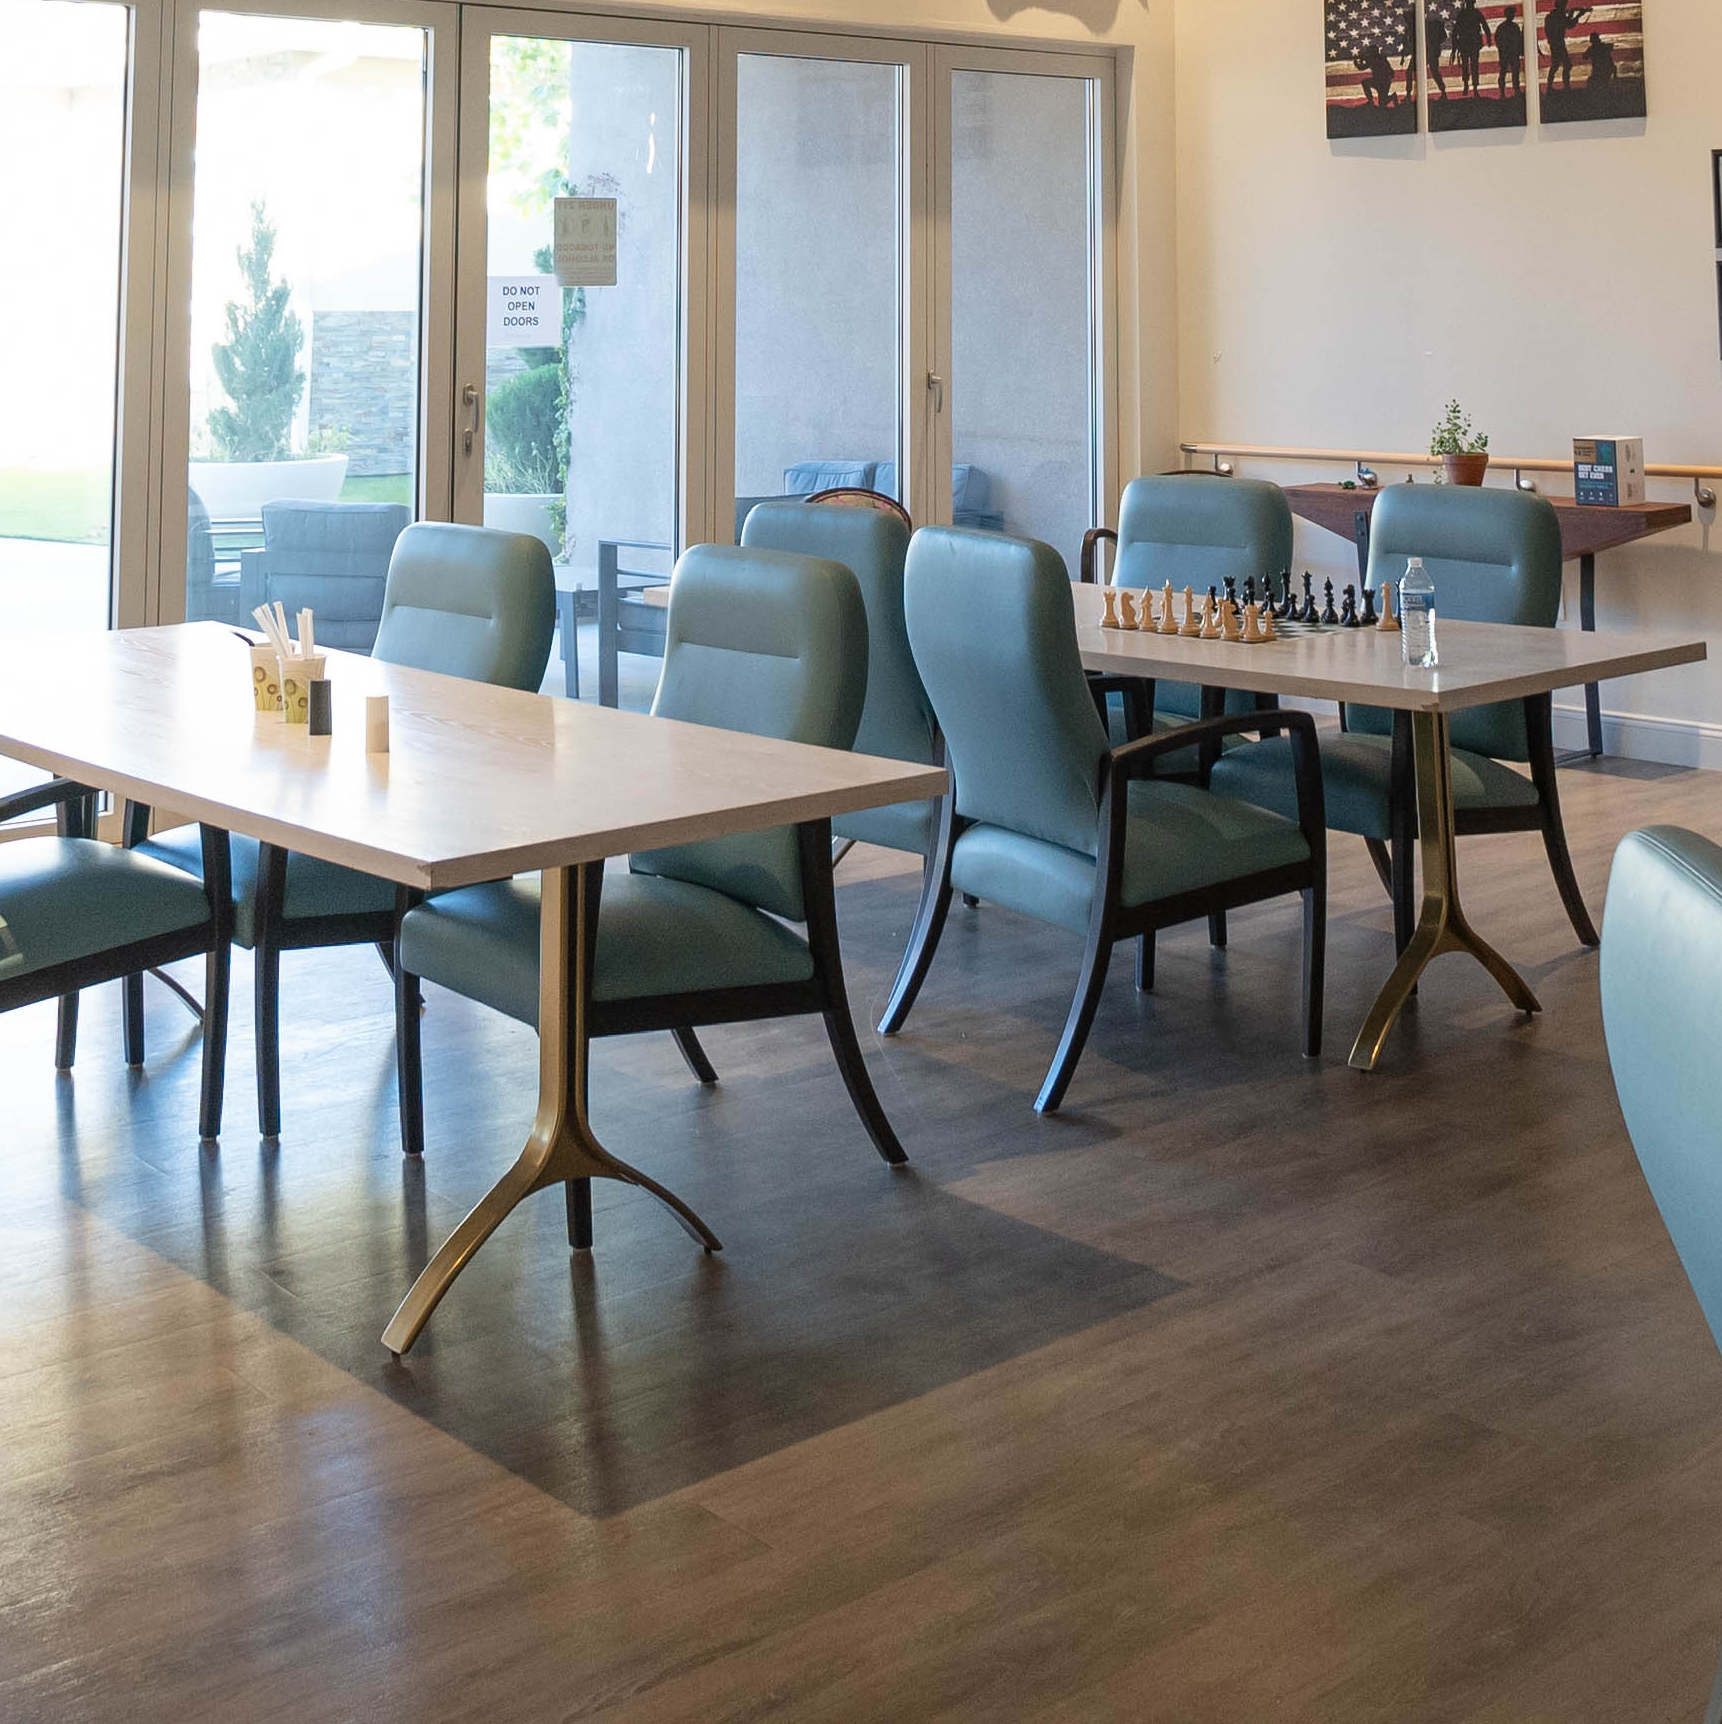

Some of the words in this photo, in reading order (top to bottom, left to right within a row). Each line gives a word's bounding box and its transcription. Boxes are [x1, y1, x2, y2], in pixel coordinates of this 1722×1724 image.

[502, 285, 518, 296] DO
[520, 285, 540, 296] NOT
[507, 301, 535, 311] OPEN
[503, 316, 539, 326] DOORS
